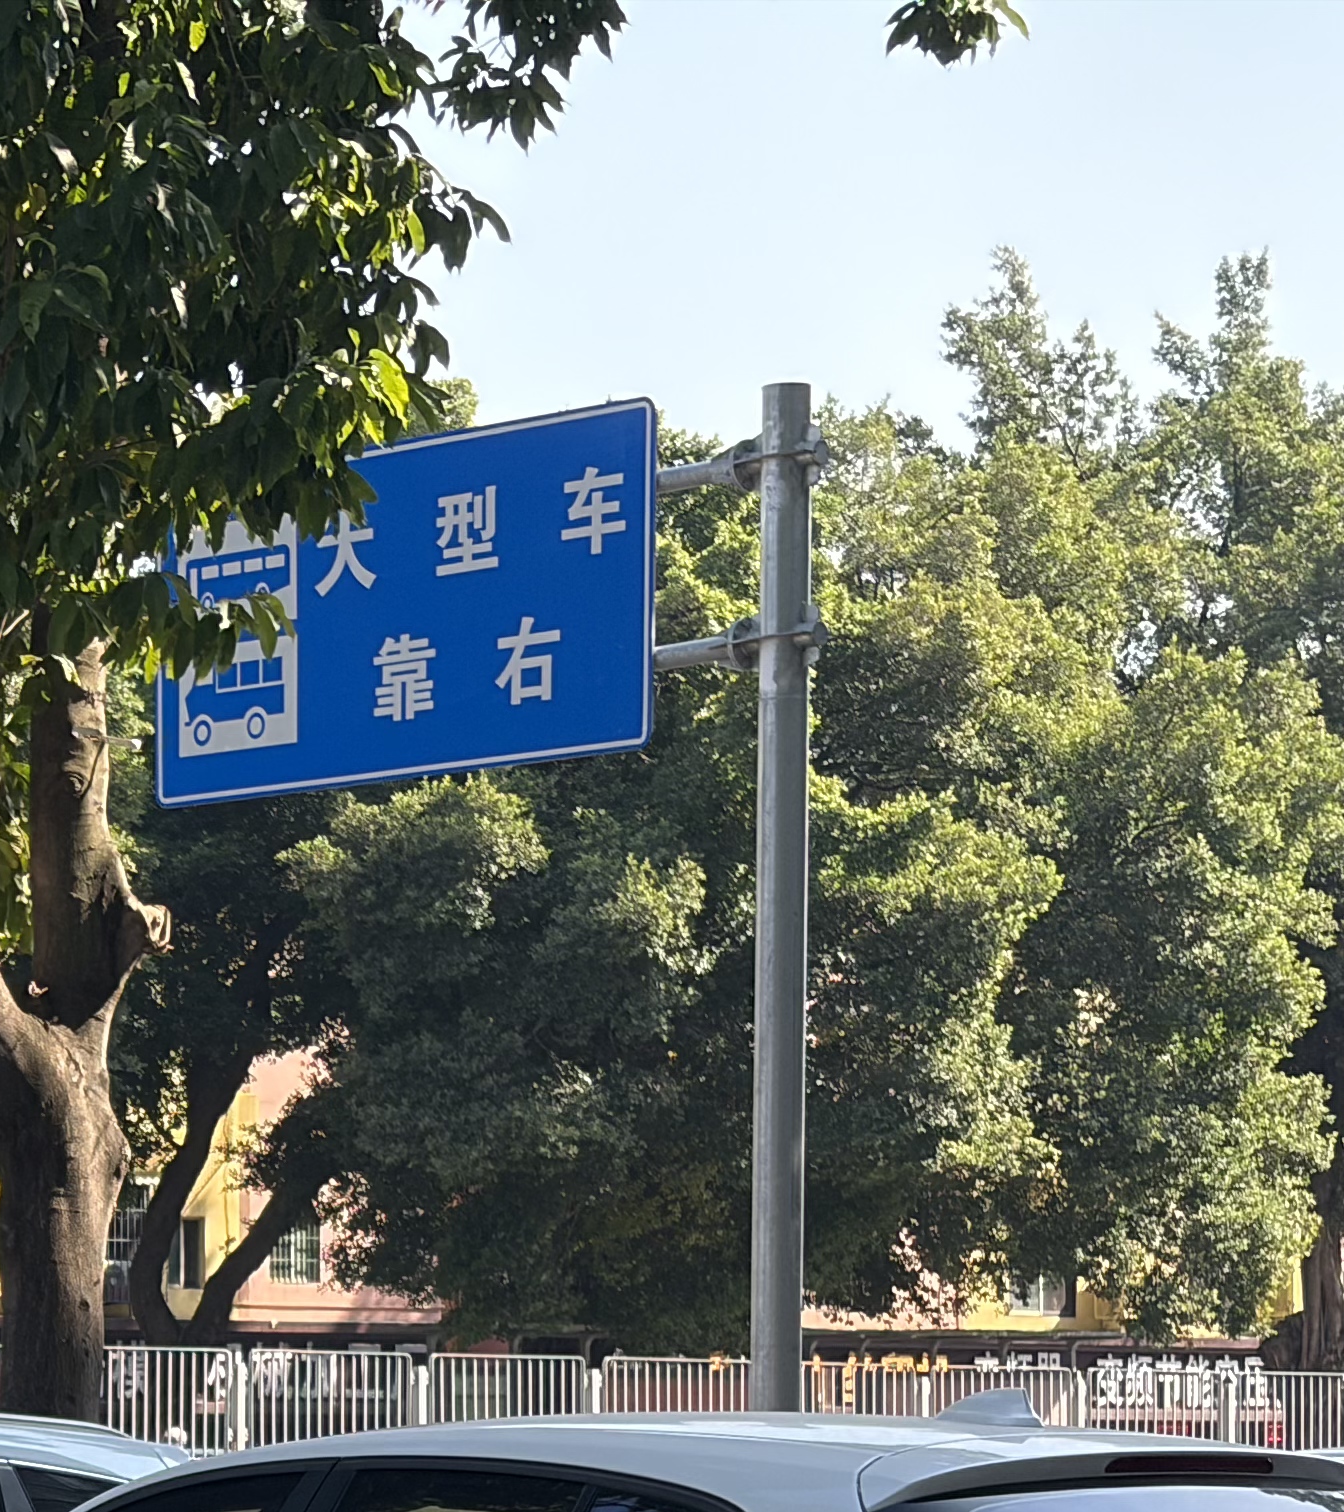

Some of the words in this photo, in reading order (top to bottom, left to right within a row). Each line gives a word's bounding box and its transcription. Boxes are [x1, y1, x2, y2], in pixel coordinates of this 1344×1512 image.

[314, 466, 627, 598] 大型车
[372, 616, 561, 722] 靠右
